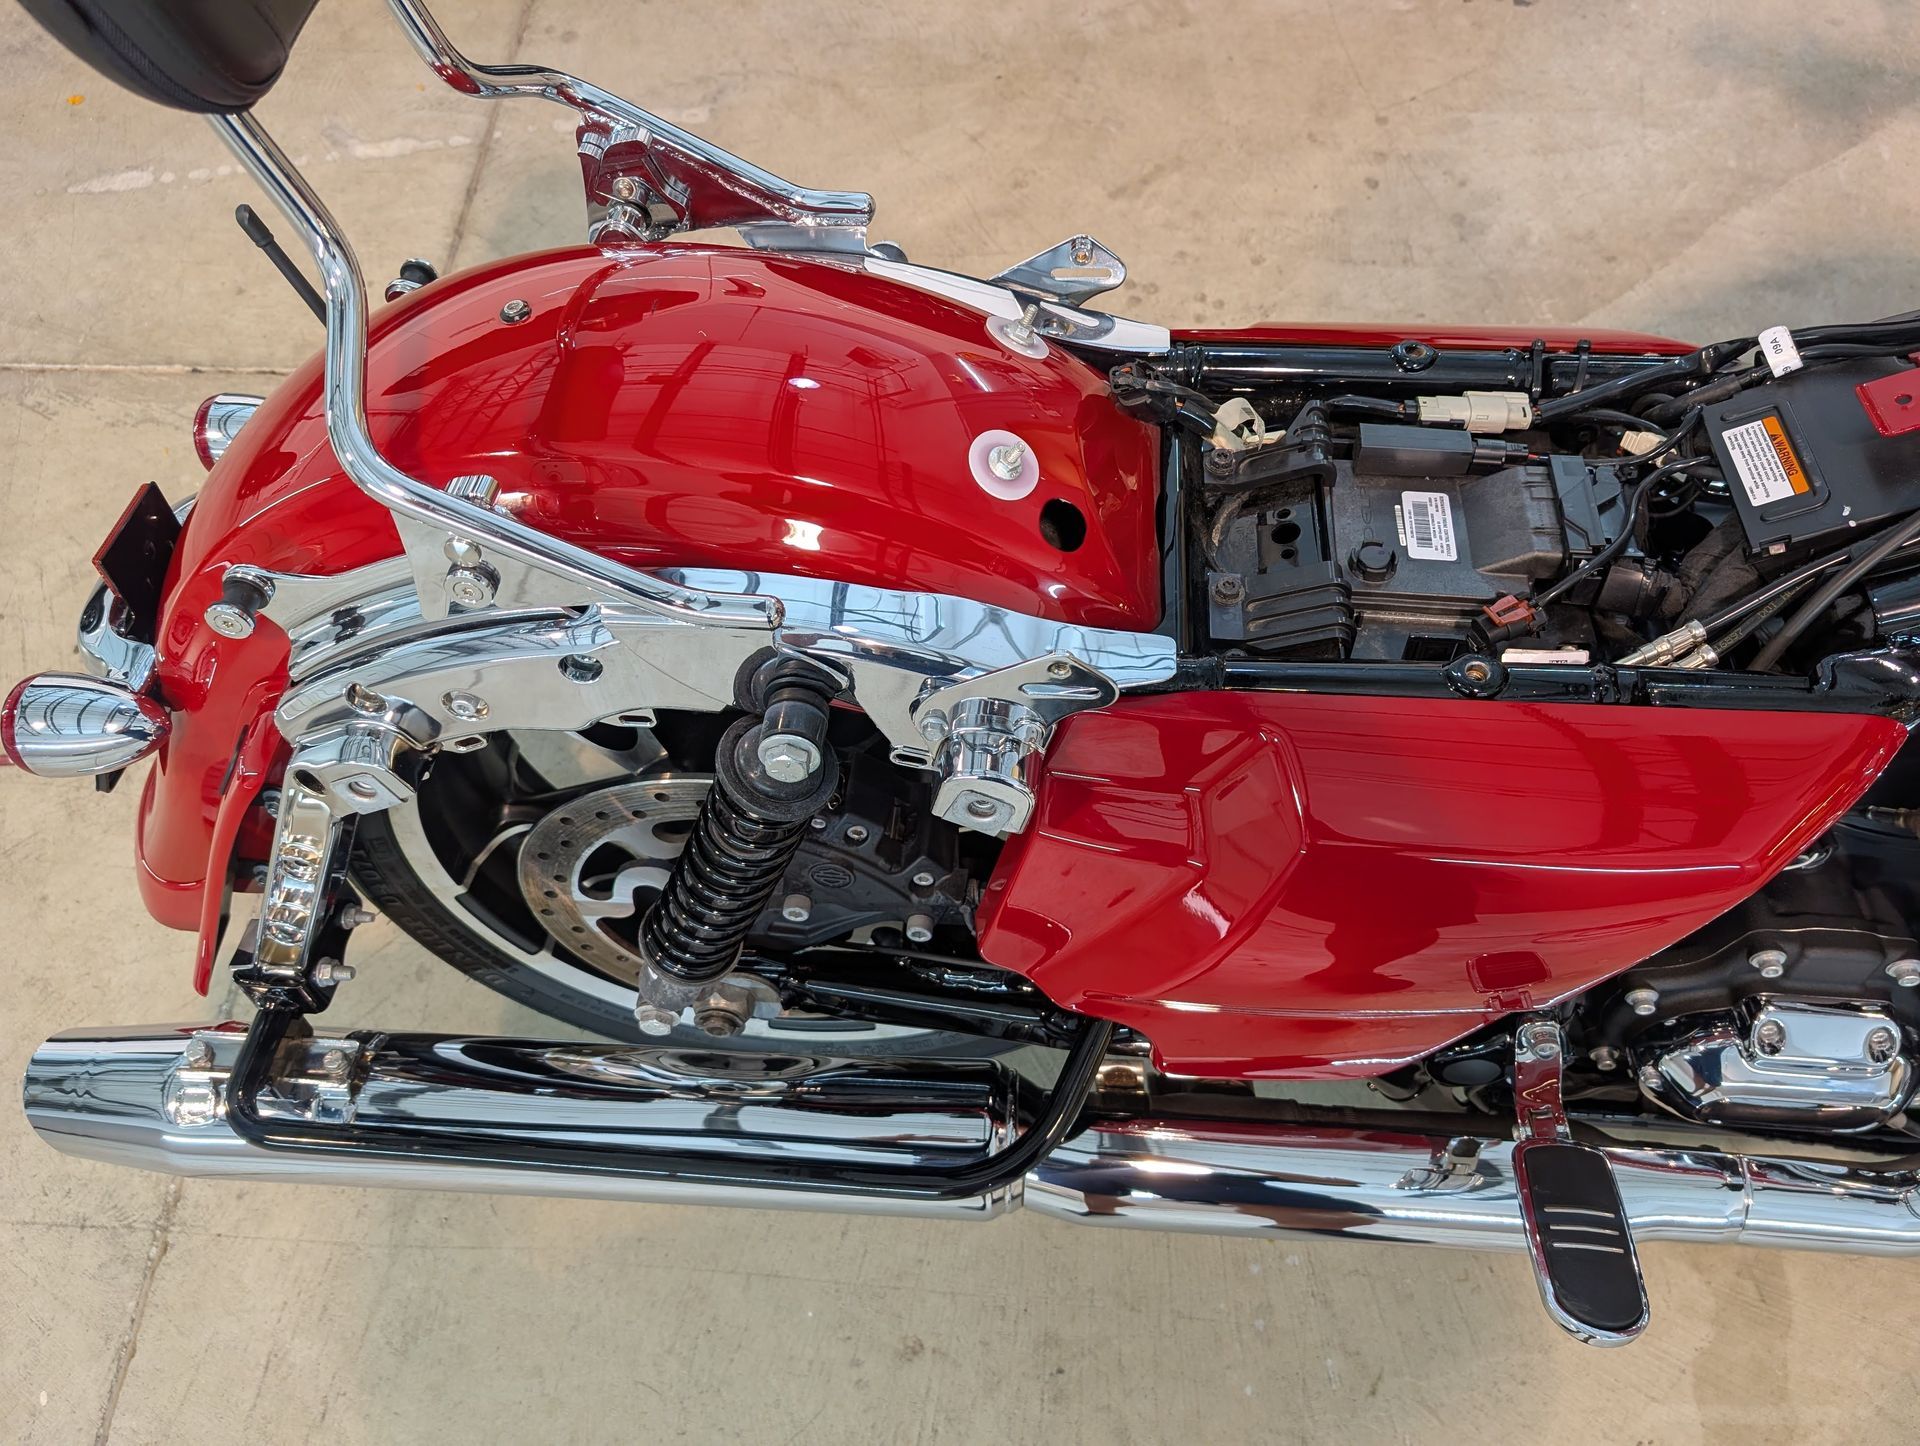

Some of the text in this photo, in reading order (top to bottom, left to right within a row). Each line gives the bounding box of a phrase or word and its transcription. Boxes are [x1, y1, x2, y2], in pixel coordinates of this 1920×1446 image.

[1770, 337, 1783, 354] 09A
[1735, 441, 1743, 450] cable
[1742, 458, 1750, 466] from
[1752, 480, 1760, 489] while
[1738, 431, 1749, 449] Disconnect
[1745, 448, 1755, 462] negative
[1751, 462, 1759, 471] cable
[1755, 471, 1764, 482] before
[1749, 440, 1758, 452] serious
[1758, 461, 1767, 471] could
[1751, 429, 1763, 446] motorcycle
[1764, 457, 1772, 466] while
[1764, 442, 1773, 453] battery
[1773, 439, 1798, 476] WARNING
[400, 914, 506, 985] DUNLOP
